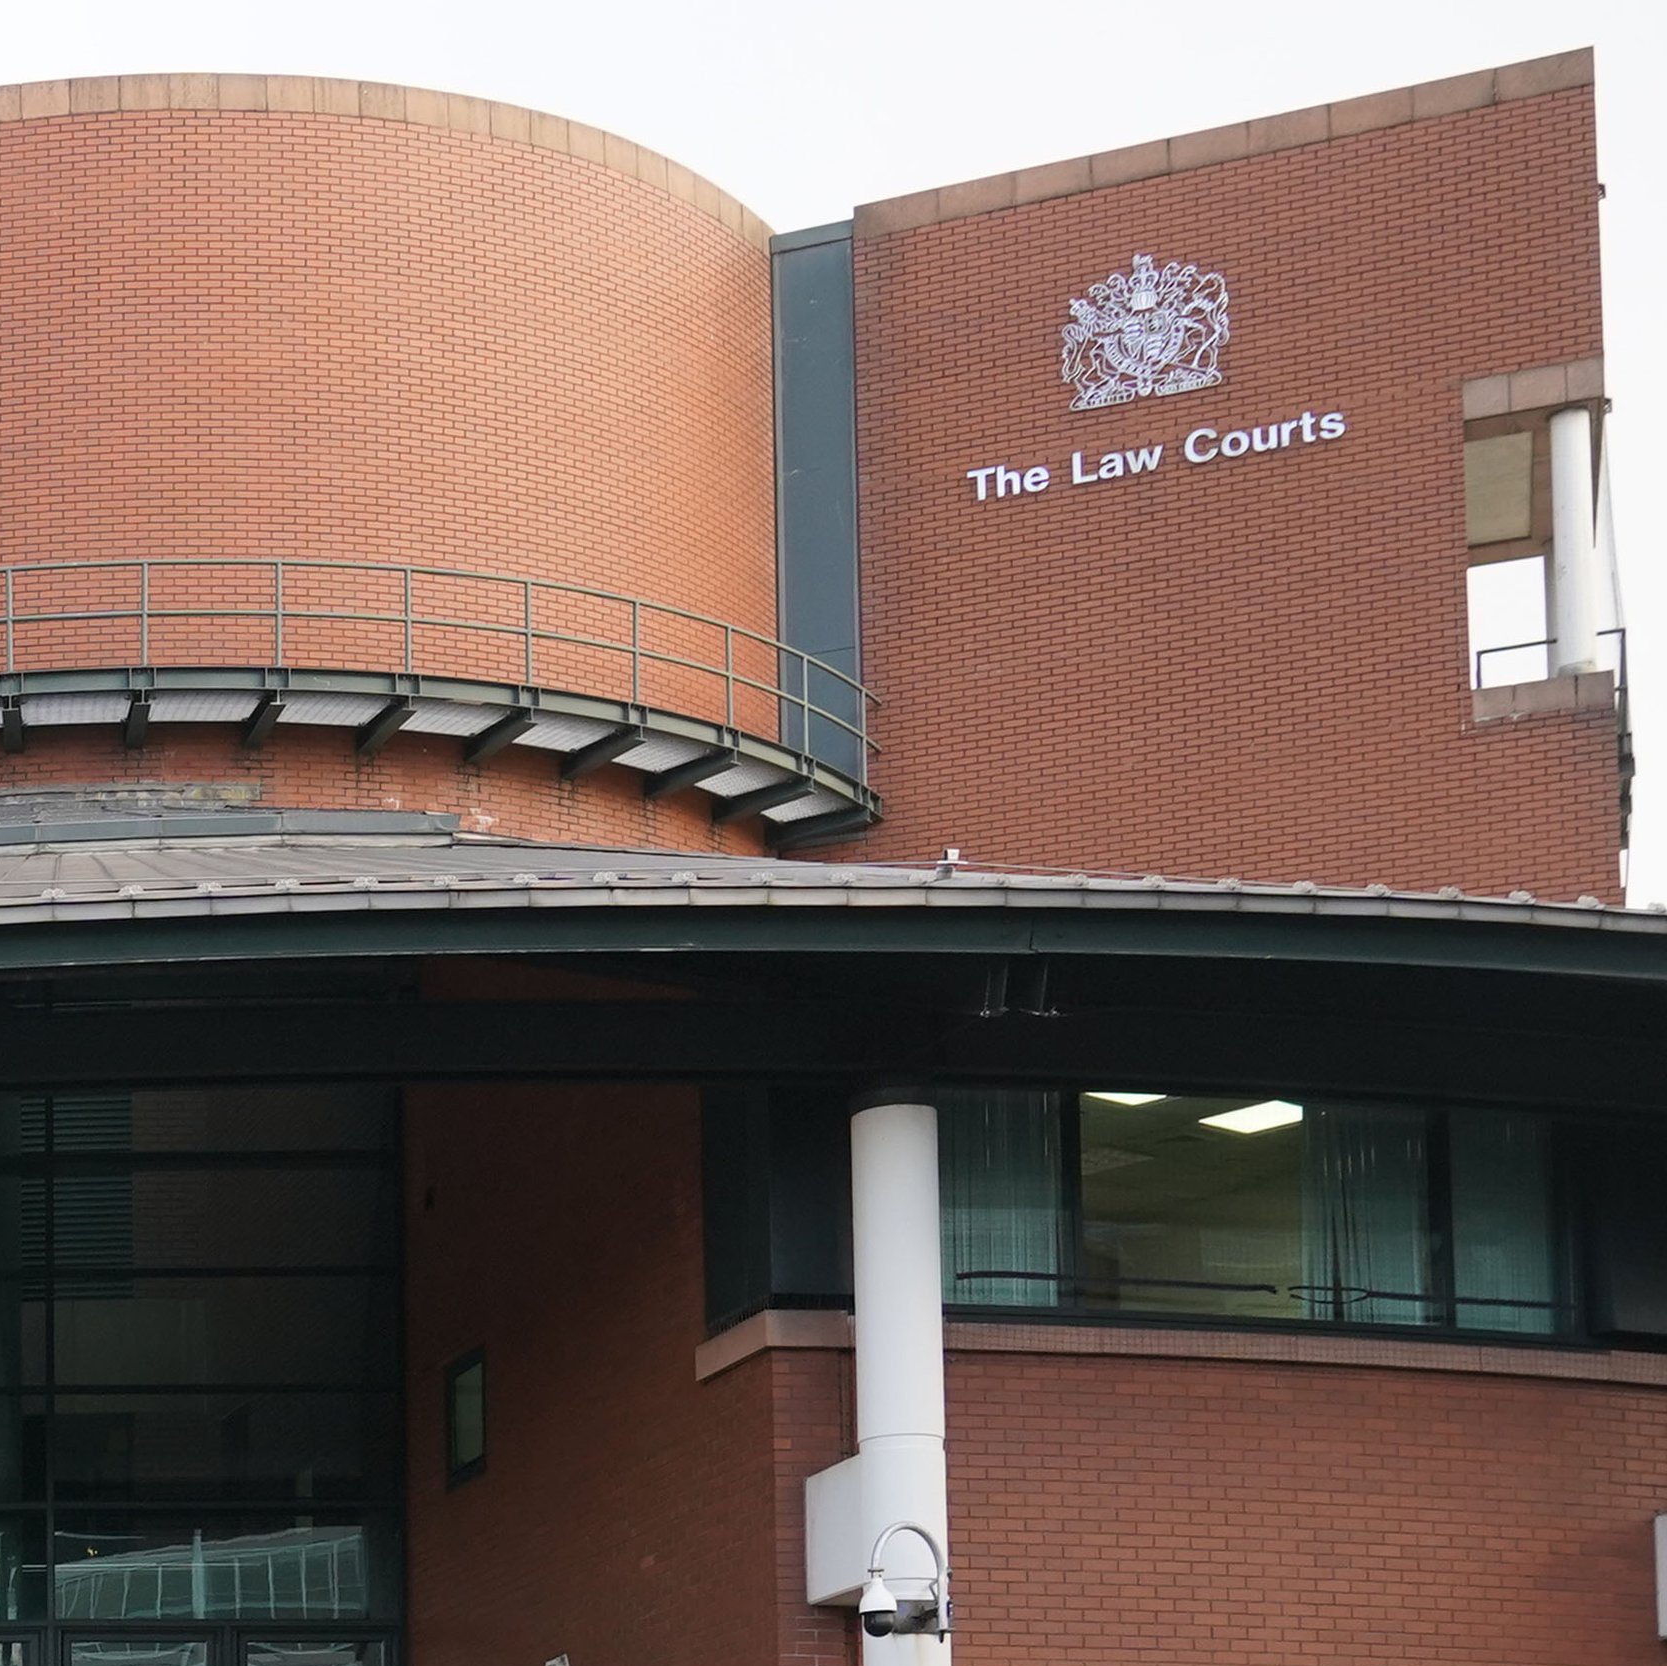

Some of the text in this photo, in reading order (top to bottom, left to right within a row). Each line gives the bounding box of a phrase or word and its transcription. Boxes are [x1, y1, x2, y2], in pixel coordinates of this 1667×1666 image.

[967, 411, 1346, 501] The Law Courts
